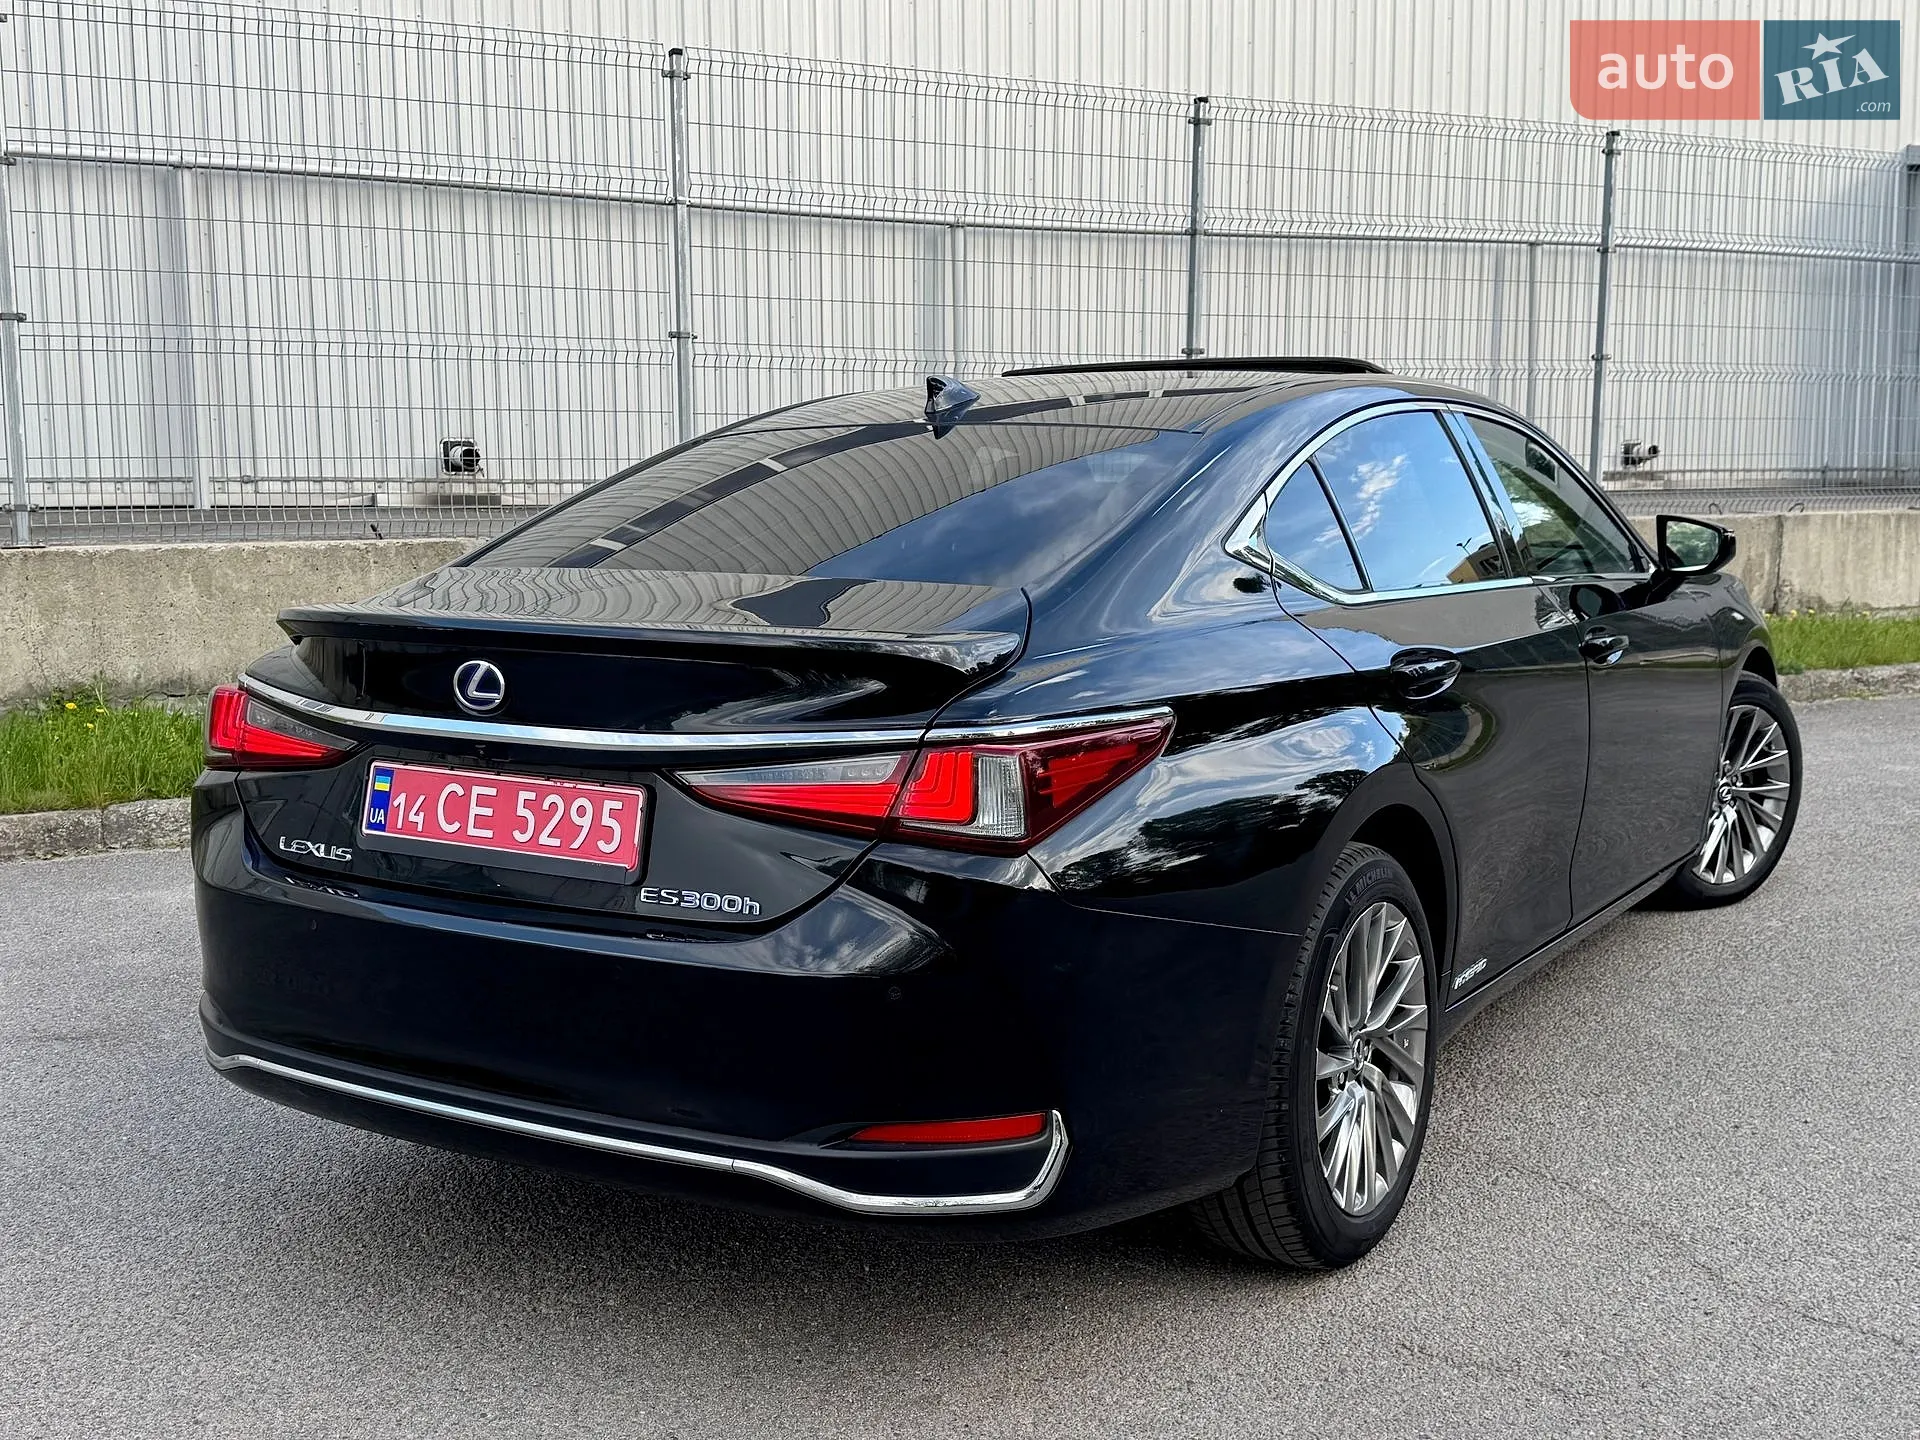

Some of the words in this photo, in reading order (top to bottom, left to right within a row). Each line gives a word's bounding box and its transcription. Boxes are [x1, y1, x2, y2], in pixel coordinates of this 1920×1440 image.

[369, 806, 385, 826] UA
[392, 792, 426, 833] 14
[436, 783, 498, 839] CE
[512, 790, 623, 854] 5295
[279, 836, 352, 861] LEXUS
[640, 887, 760, 915] ES300h
